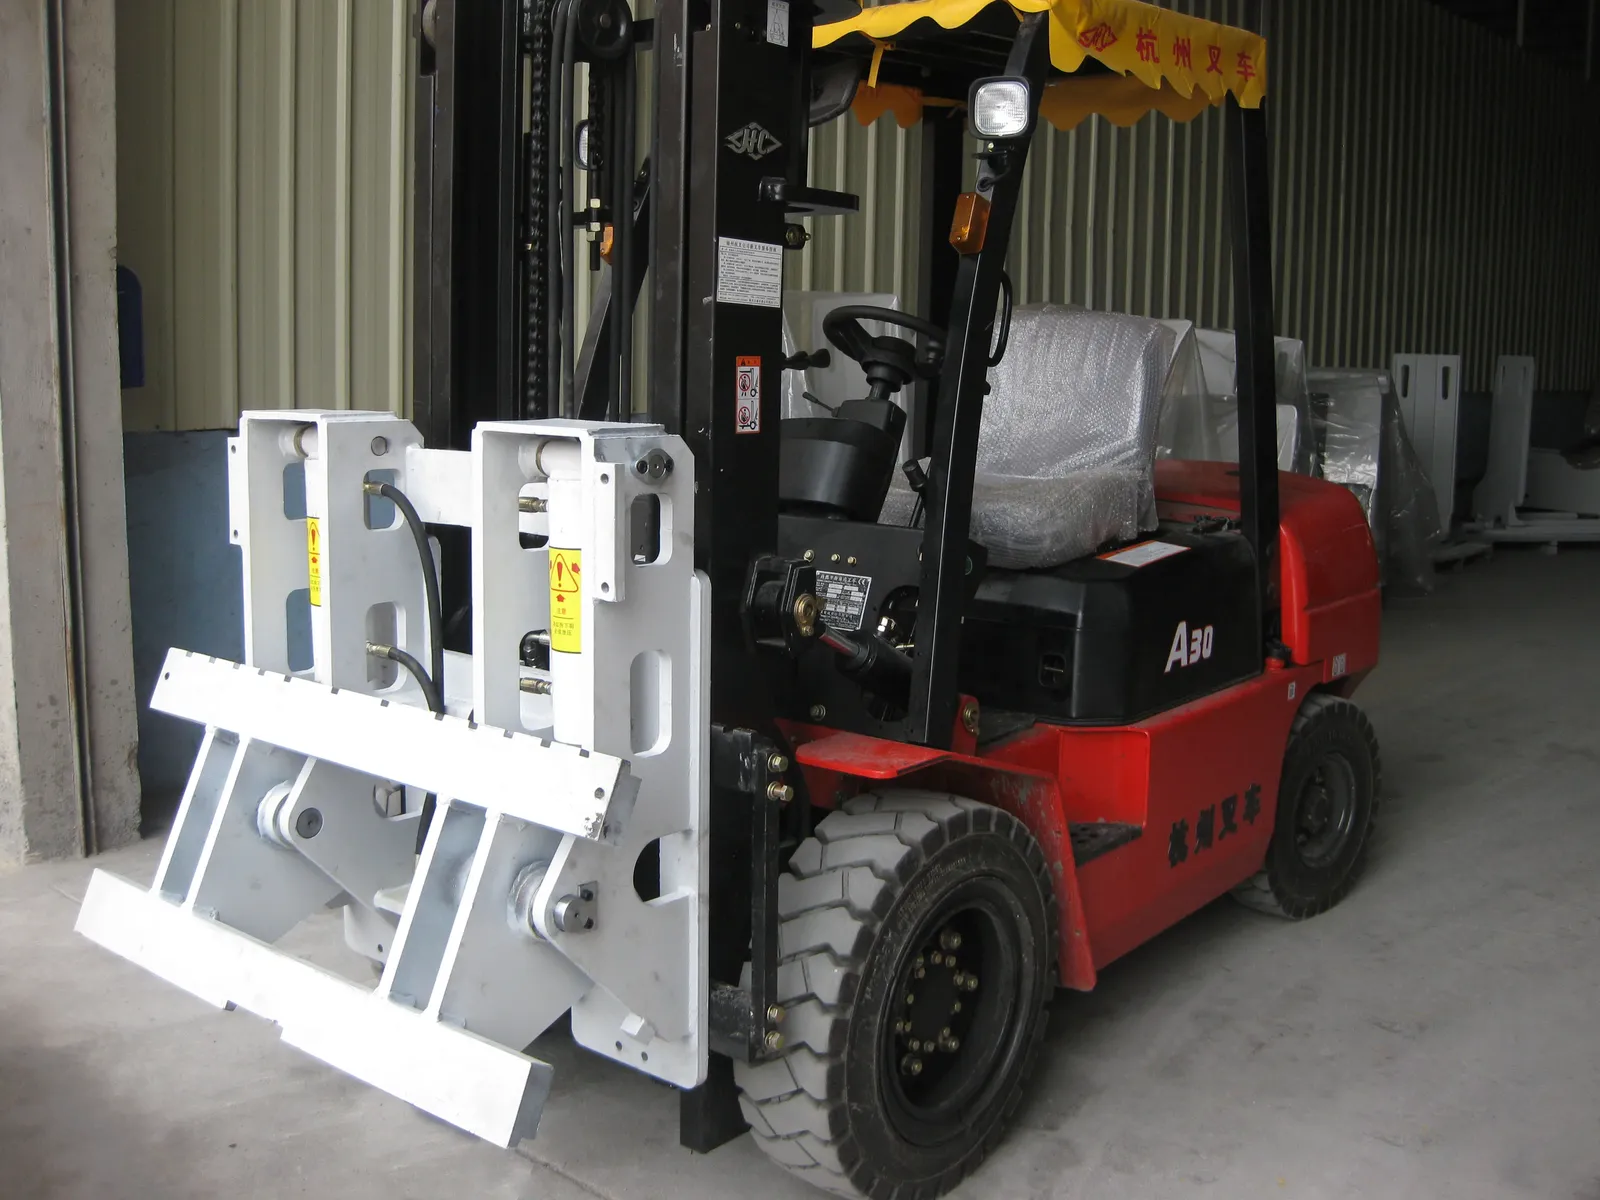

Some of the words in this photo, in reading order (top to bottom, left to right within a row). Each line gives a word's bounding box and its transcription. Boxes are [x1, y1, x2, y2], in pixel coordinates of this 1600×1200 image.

[1136, 27, 1257, 82] 杭州叉车
[1164, 620, 1214, 673] A30
